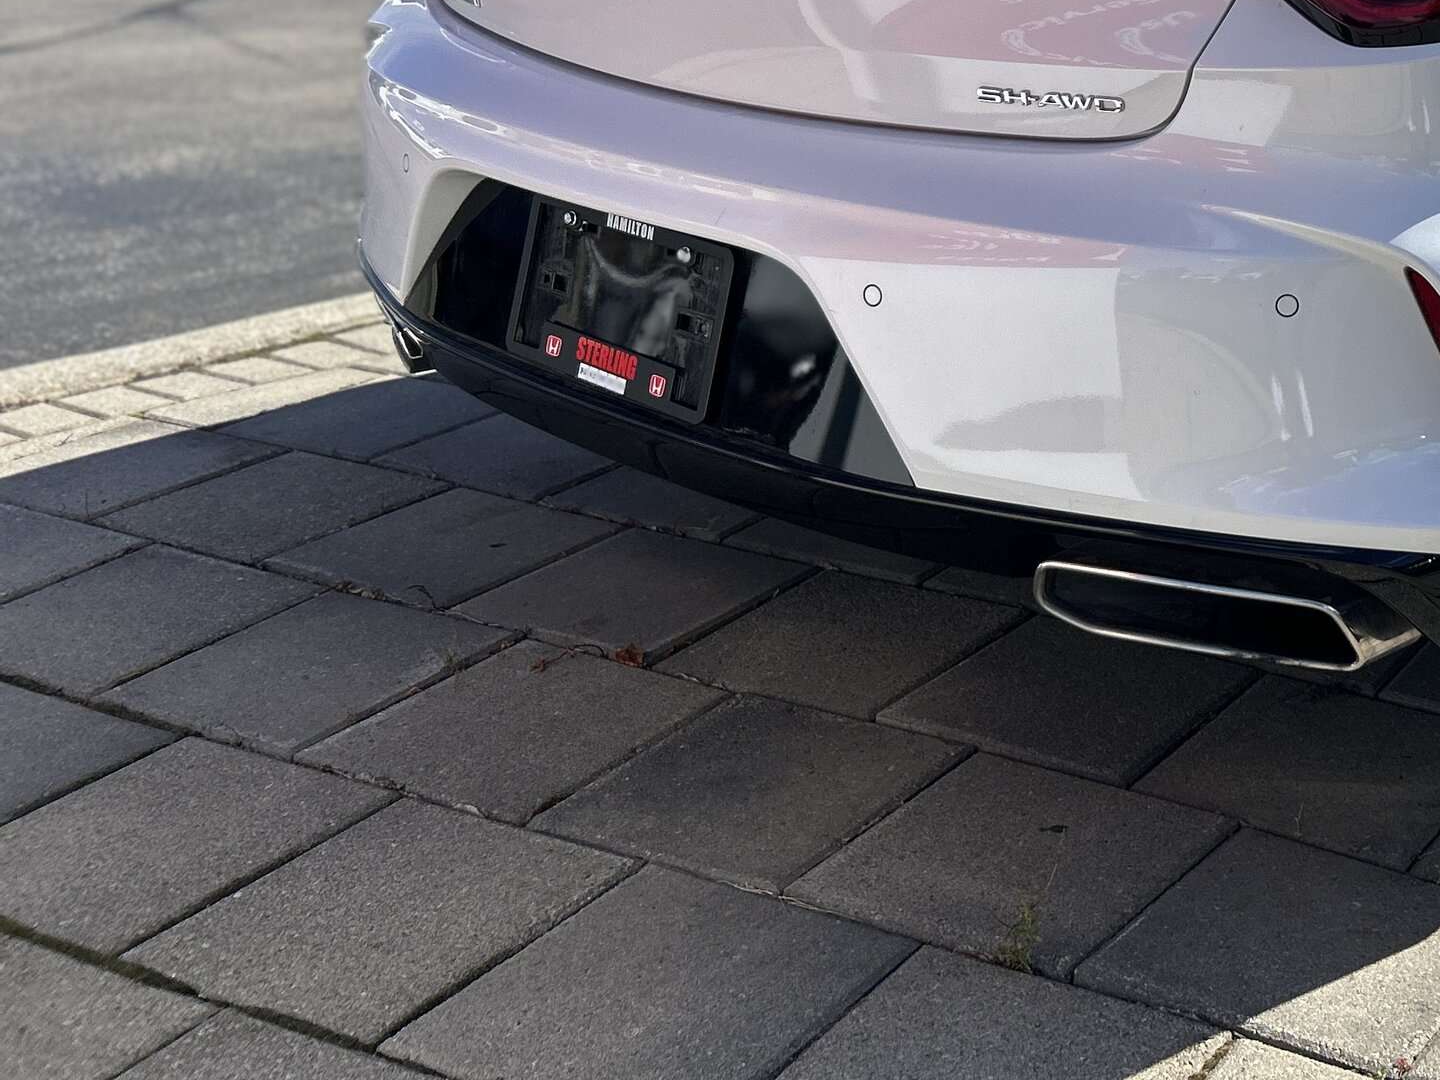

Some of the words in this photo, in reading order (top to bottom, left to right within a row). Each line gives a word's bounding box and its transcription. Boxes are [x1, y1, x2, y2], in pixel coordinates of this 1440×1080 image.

[976, 86, 1126, 113] SH-AWD
[606, 213, 655, 240] HAMILTON
[576, 337, 638, 380] STERLING
